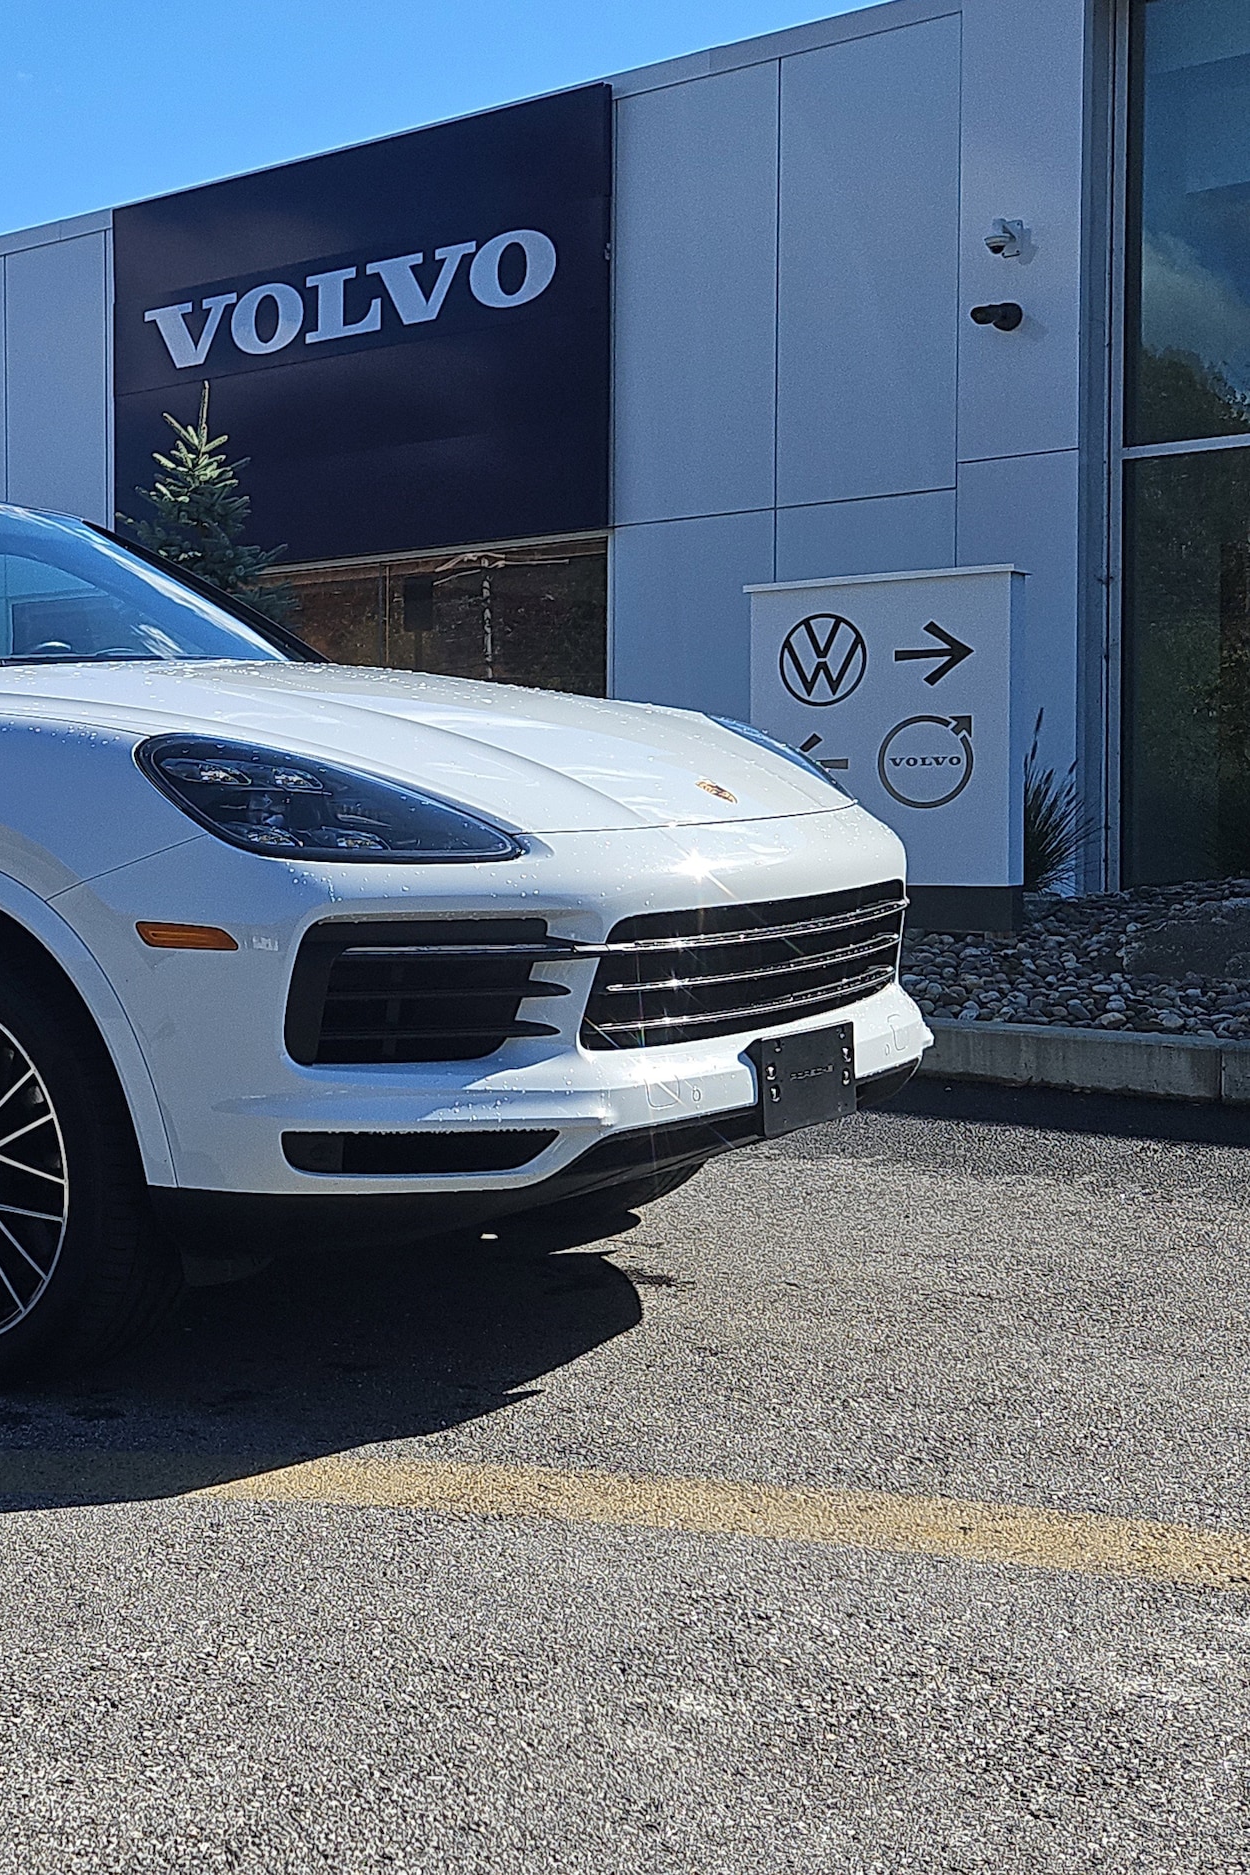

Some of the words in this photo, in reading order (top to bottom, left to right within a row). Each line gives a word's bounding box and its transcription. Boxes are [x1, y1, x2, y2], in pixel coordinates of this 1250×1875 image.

[143, 229, 557, 369] VOLVO
[782, 616, 864, 701] VW
[888, 755, 962, 767] VOLVO
